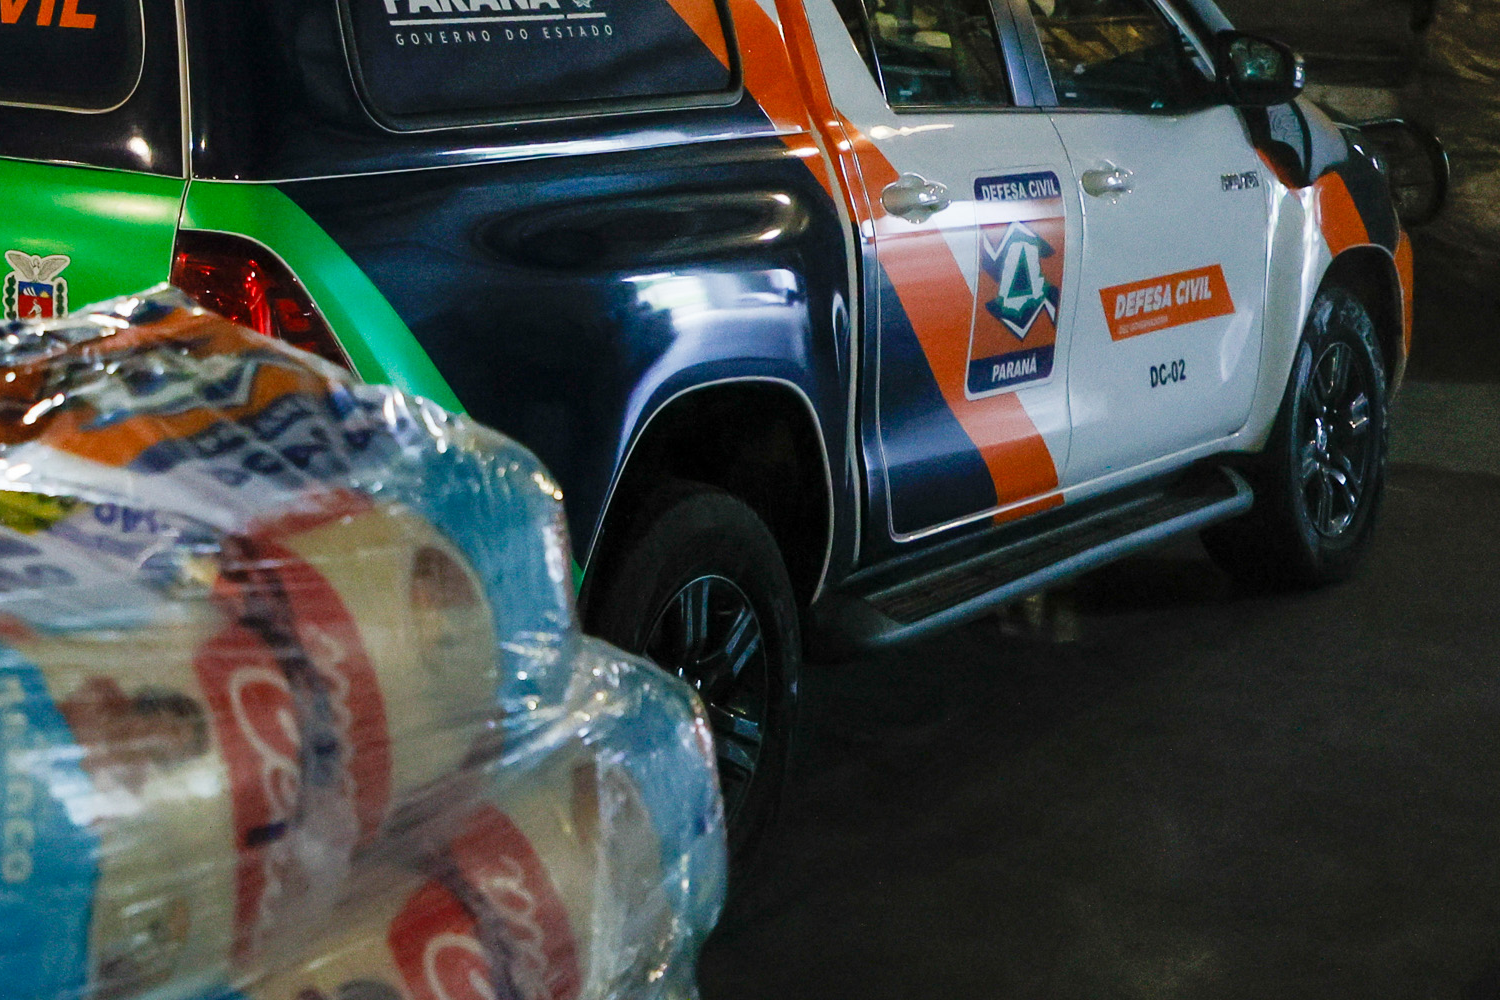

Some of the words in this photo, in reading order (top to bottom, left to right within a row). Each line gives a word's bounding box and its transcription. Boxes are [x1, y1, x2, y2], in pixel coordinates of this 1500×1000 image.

[395, 28, 491, 46] GOVERNO
[505, 27, 529, 41] DO
[543, 24, 614, 40] ESTADO
[981, 180, 1026, 201] DEFESA
[1028, 177, 1059, 199] CIVIL
[1114, 282, 1173, 320] DEFESA
[1175, 276, 1212, 306] CIVIL
[991, 353, 1038, 383] PARANÁ
[1150, 358, 1187, 389] DC-02
